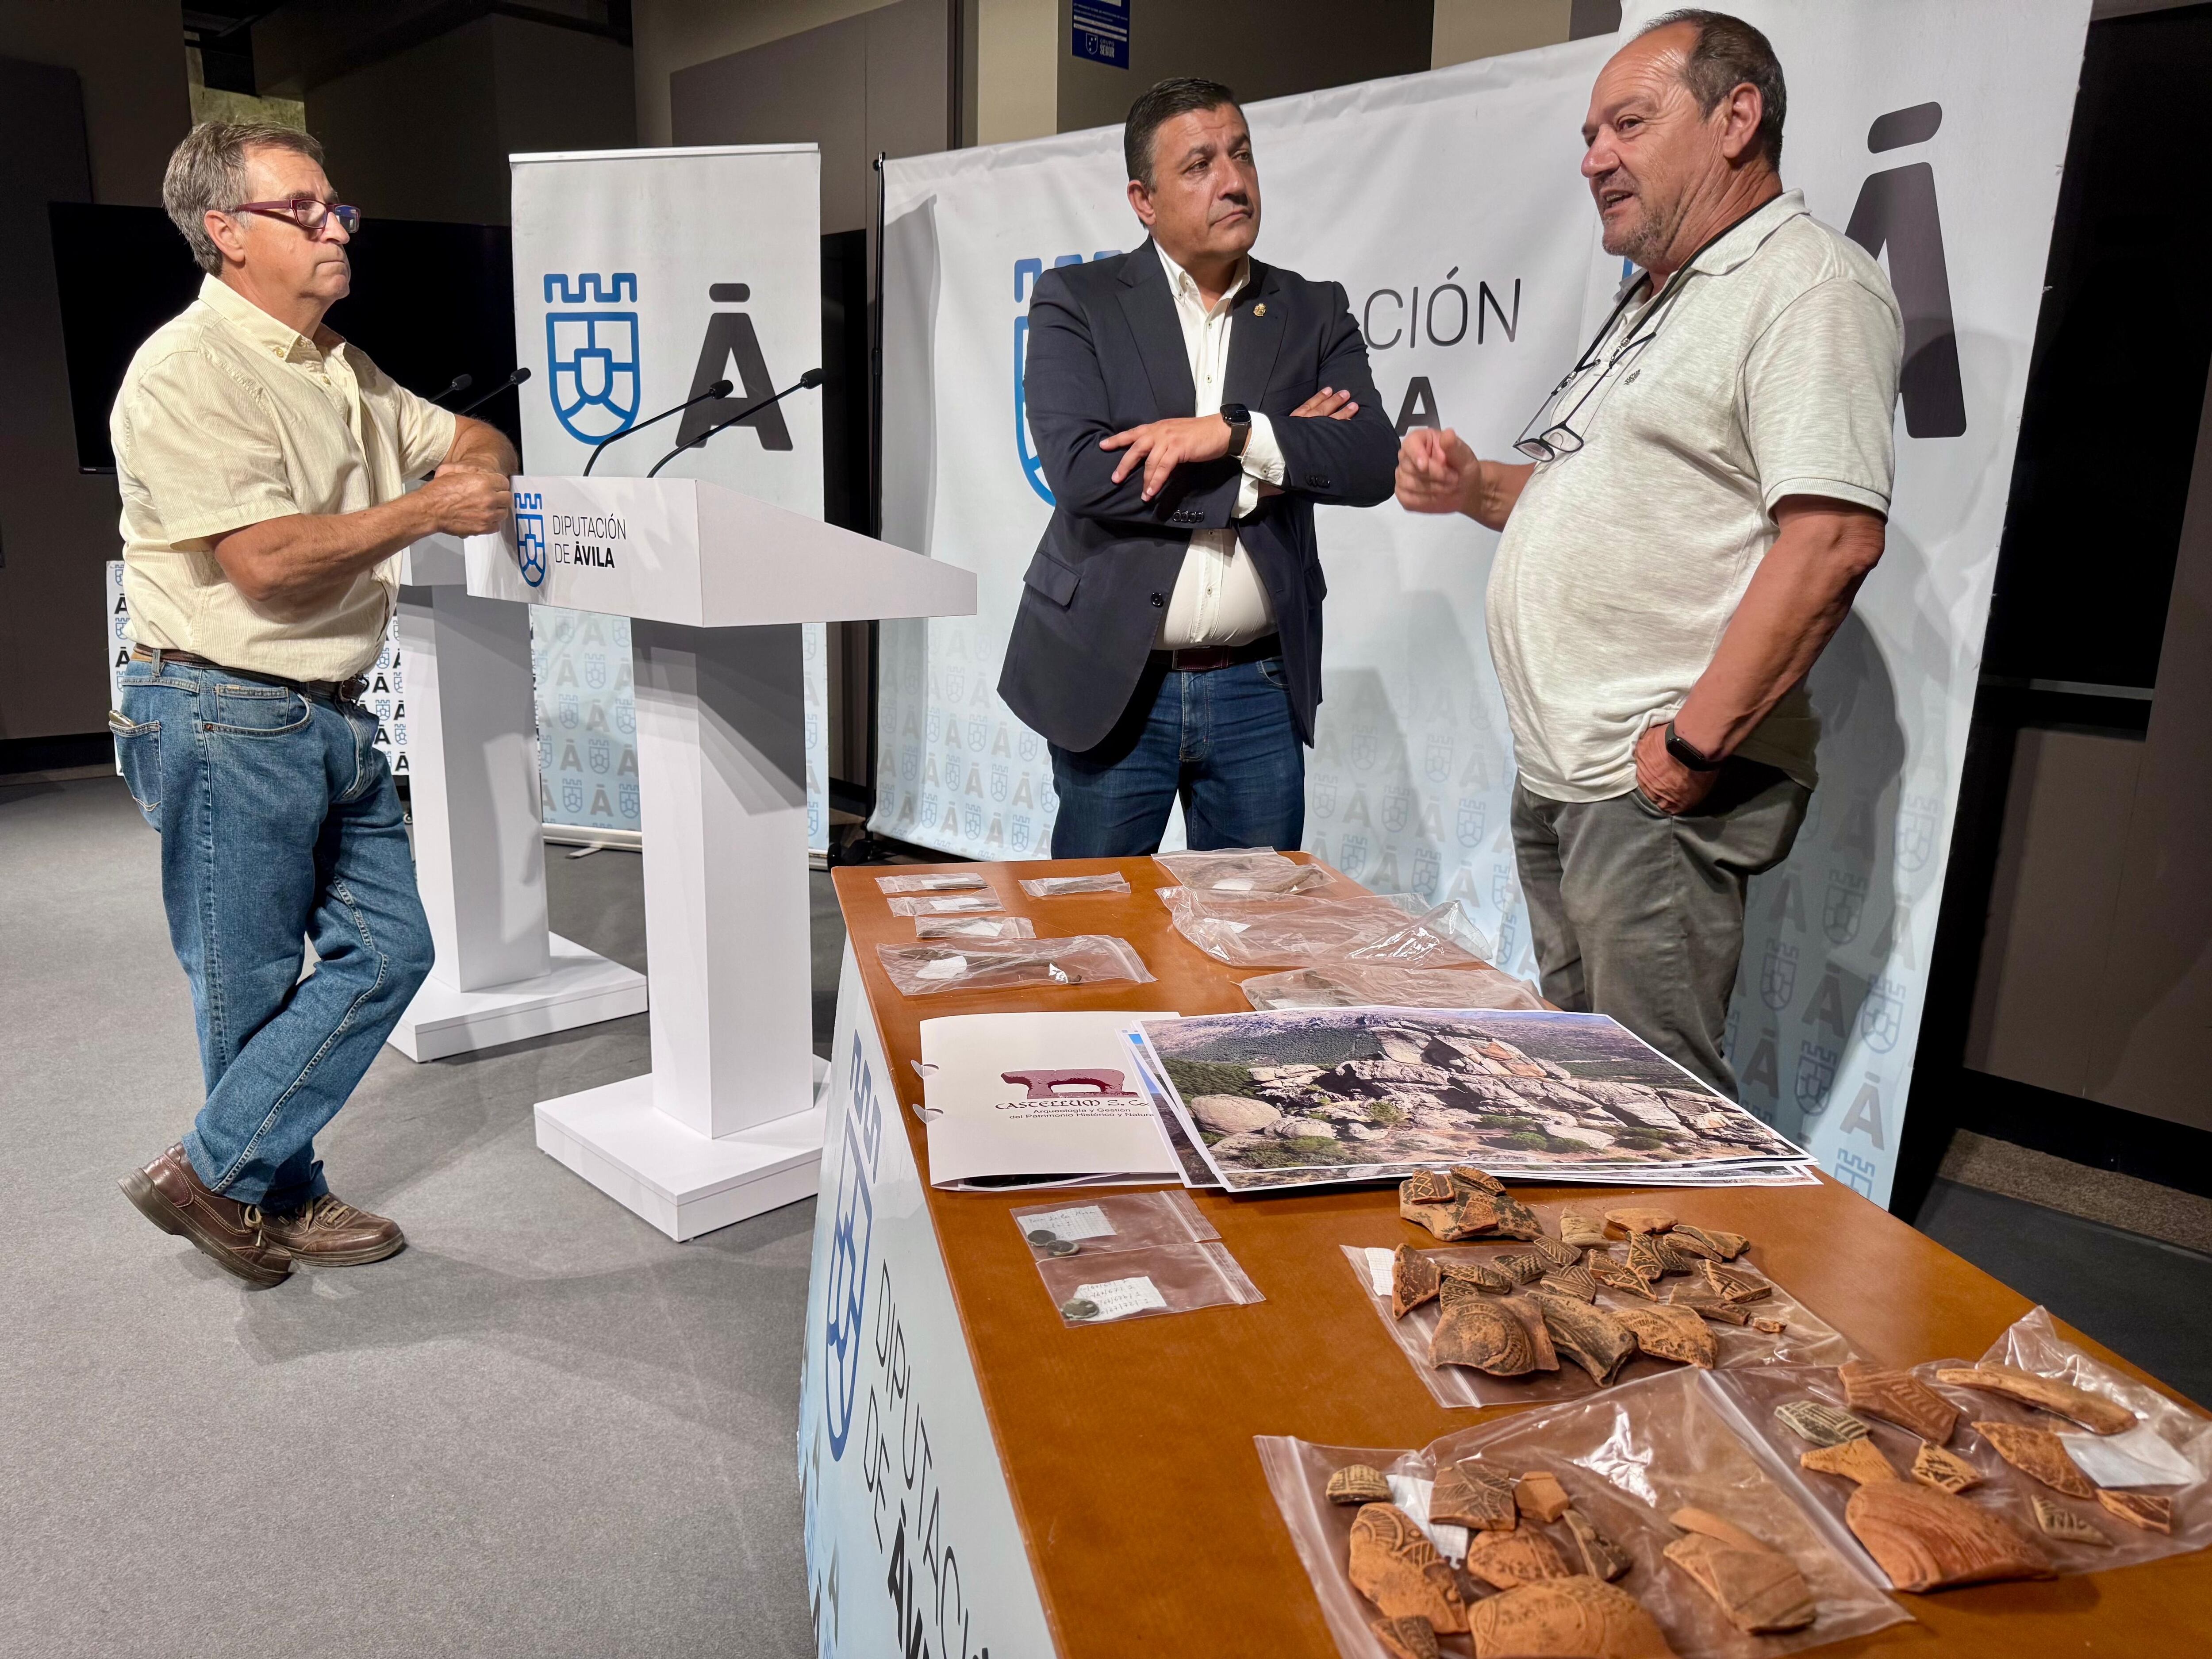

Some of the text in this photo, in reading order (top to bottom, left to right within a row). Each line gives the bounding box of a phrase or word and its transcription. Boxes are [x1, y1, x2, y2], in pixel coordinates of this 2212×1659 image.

[553, 513, 626, 540] DIPUTACIÓN
[555, 543, 570, 564] DE
[995, 1099, 1100, 1110] CASTELLUM
